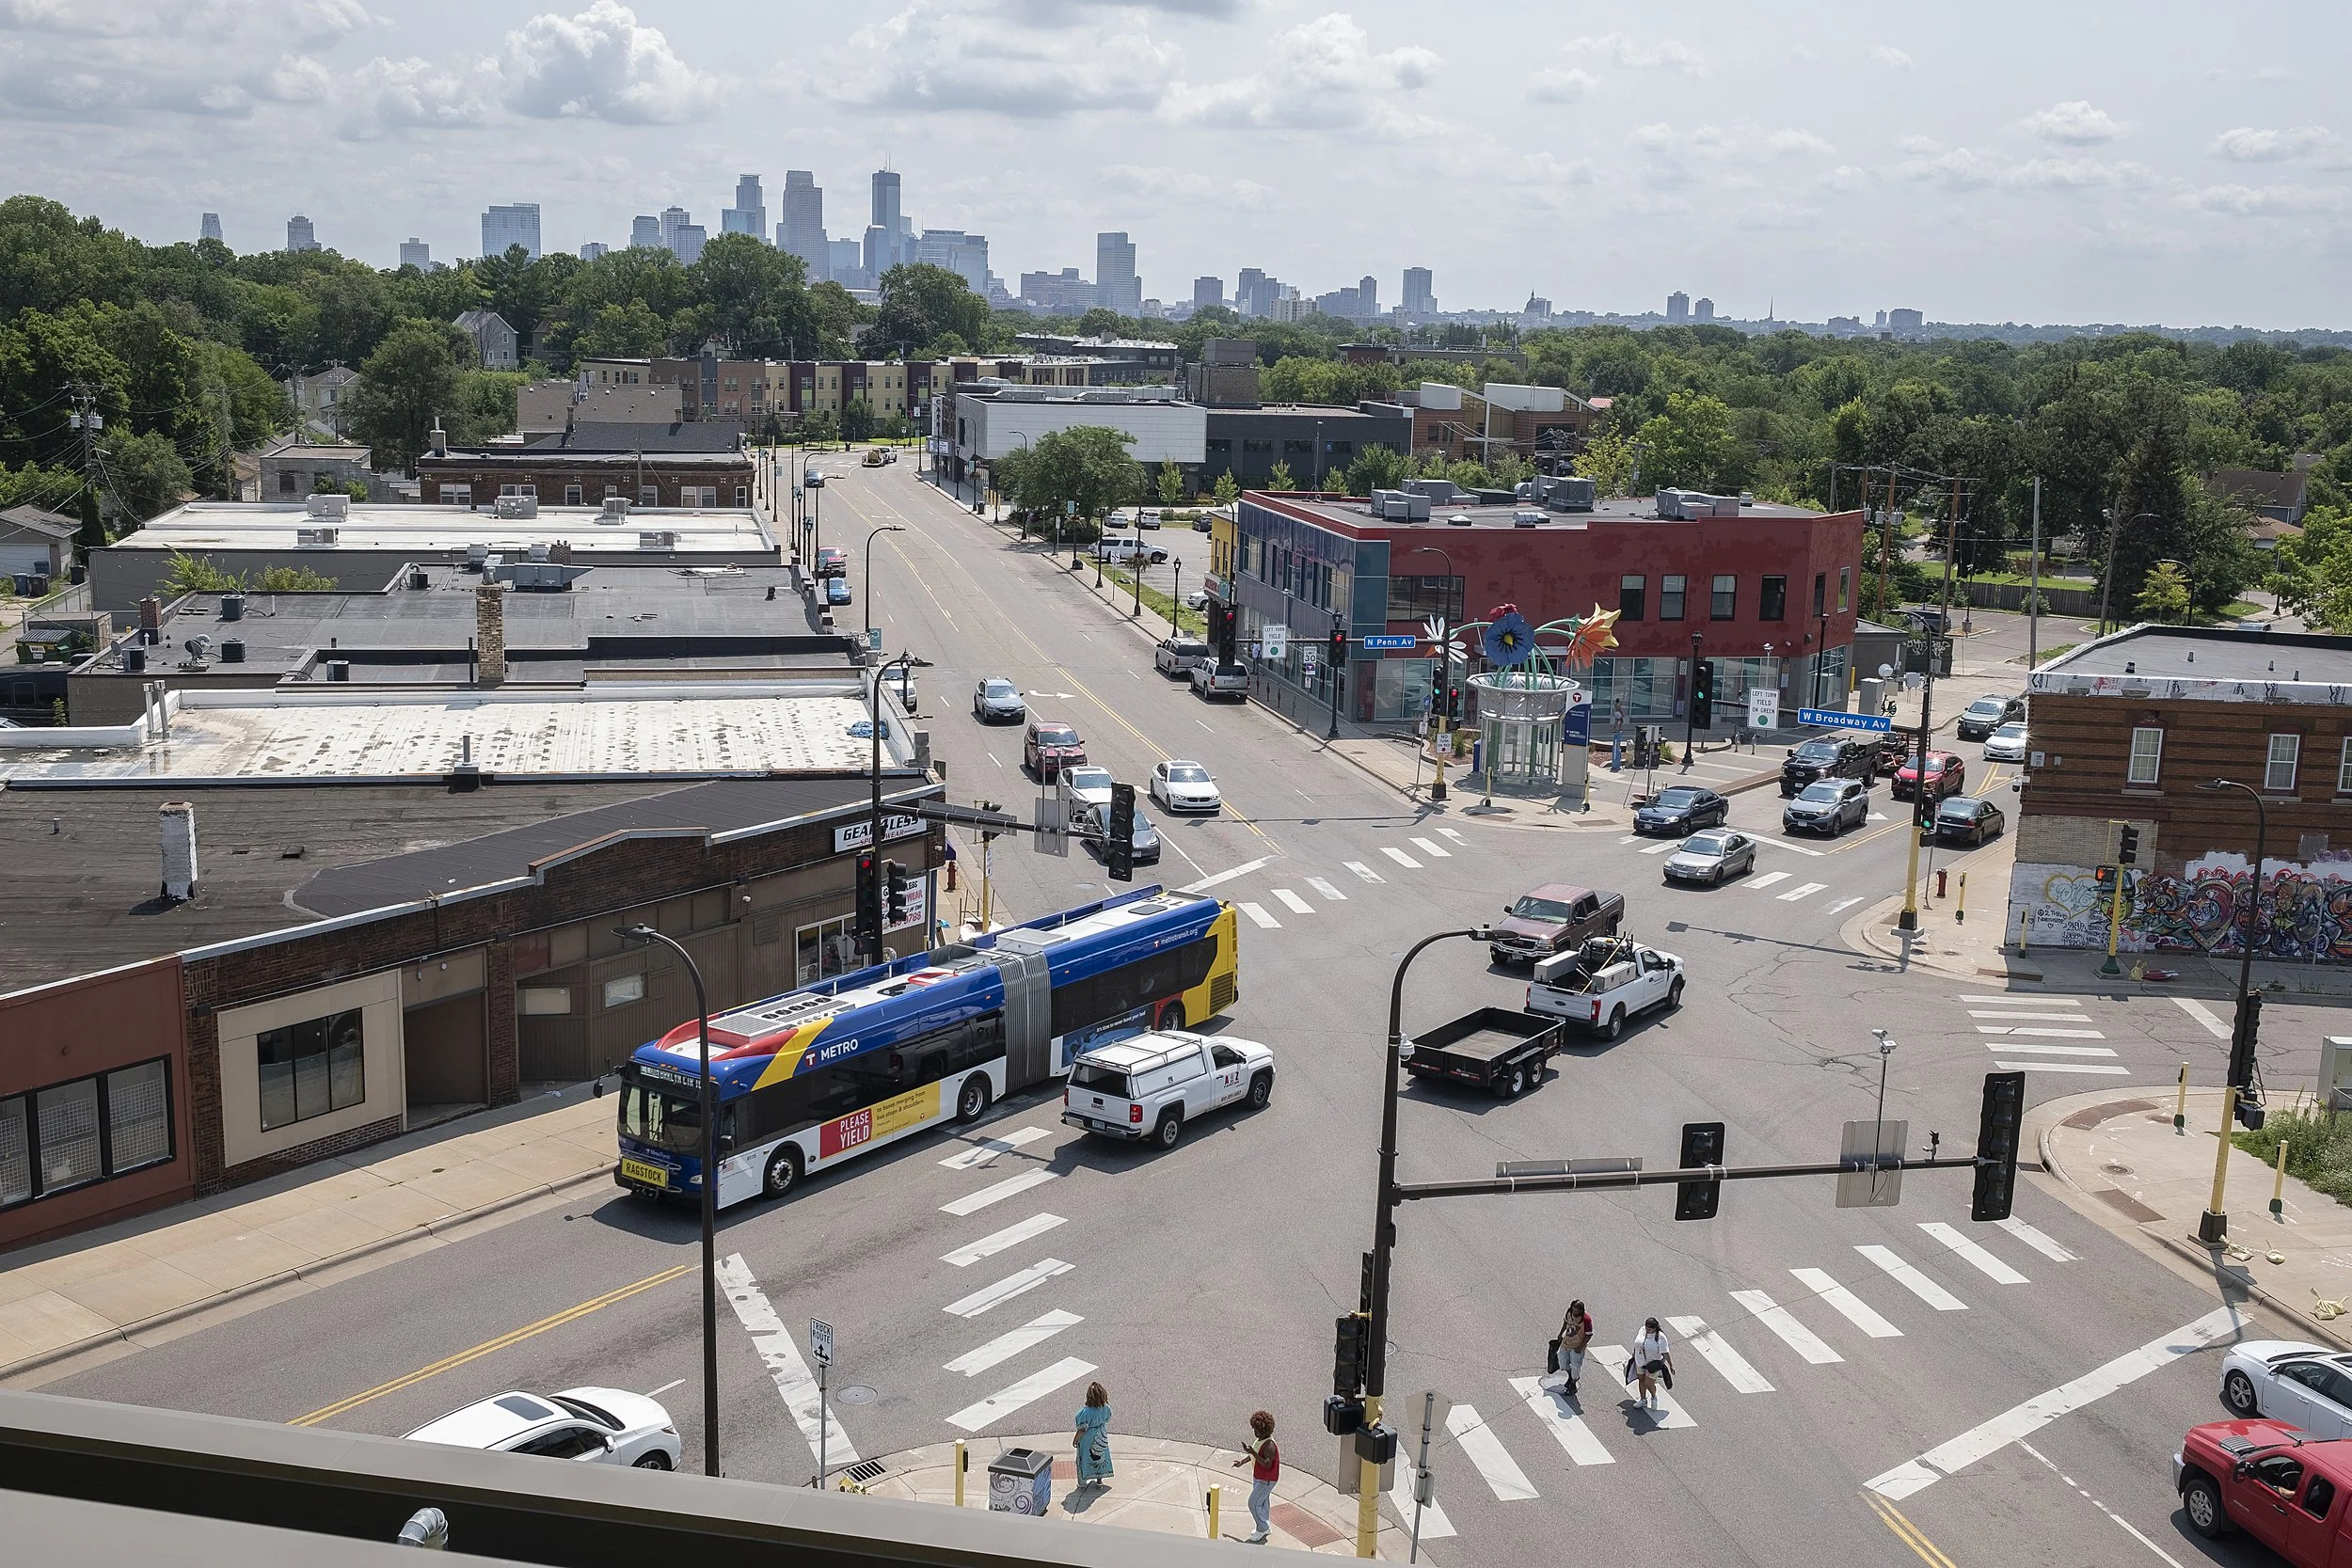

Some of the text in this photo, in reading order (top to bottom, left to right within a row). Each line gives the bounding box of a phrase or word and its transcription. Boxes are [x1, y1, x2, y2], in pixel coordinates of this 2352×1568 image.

[1803, 712, 1886, 729] W Broadway Av
[1160, 928, 1198, 945] metrotransit.org
[820, 1038, 859, 1061] METRO
[1225, 1075, 1229, 1085] A
[896, 1095, 914, 1107] merging
[840, 1111, 869, 1132] PLEASE
[840, 1126, 869, 1149] YIELD
[626, 1163, 661, 1183] RAGSTOCK
[812, 1321, 831, 1335] TRUCK
[812, 1330, 830, 1344] ROUTE
